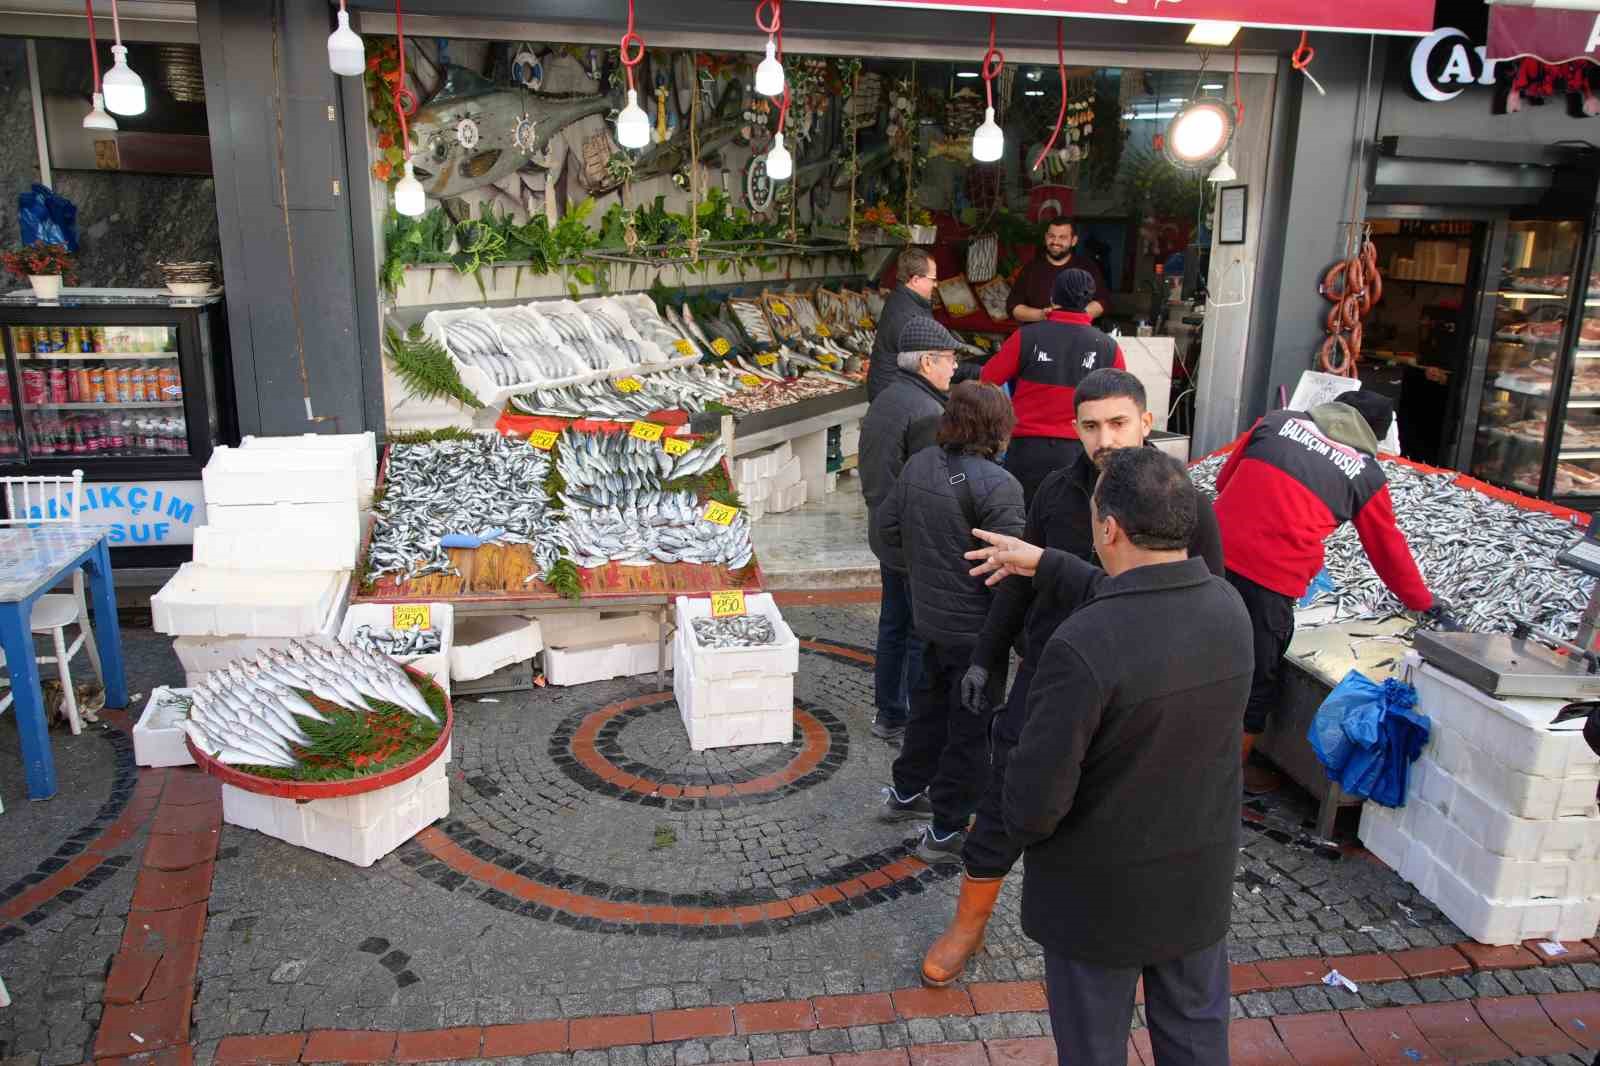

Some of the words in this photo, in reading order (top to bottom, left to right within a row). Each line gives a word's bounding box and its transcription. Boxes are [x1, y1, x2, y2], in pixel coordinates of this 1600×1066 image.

[1279, 419, 1330, 456] BALIKÇIM
[1329, 447, 1366, 479] YUSUF
[109, 522, 170, 543] SUF
